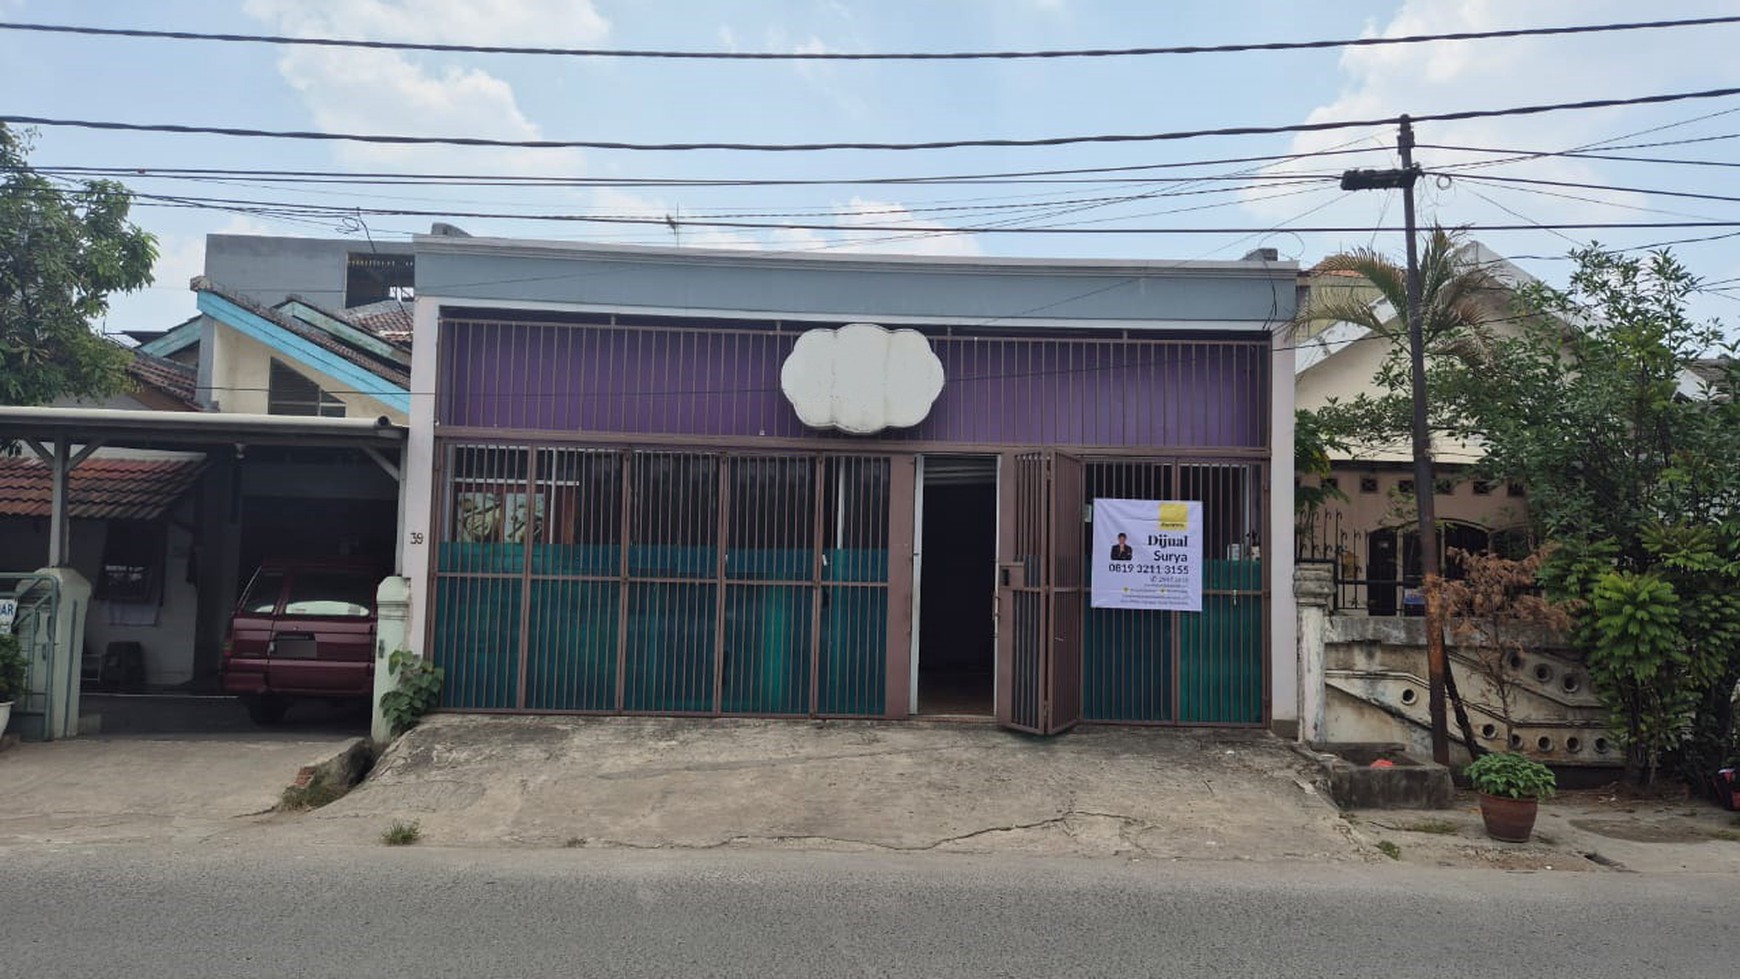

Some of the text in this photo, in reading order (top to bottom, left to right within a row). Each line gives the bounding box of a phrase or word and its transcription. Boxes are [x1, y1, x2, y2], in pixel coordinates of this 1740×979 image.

[410, 532, 424, 545] 39
[1147, 534, 1188, 549] Dijual
[1153, 550, 1188, 563] Surya
[1109, 563, 1189, 575] 0819 3211 3155
[0, 603, 14, 616] AR
